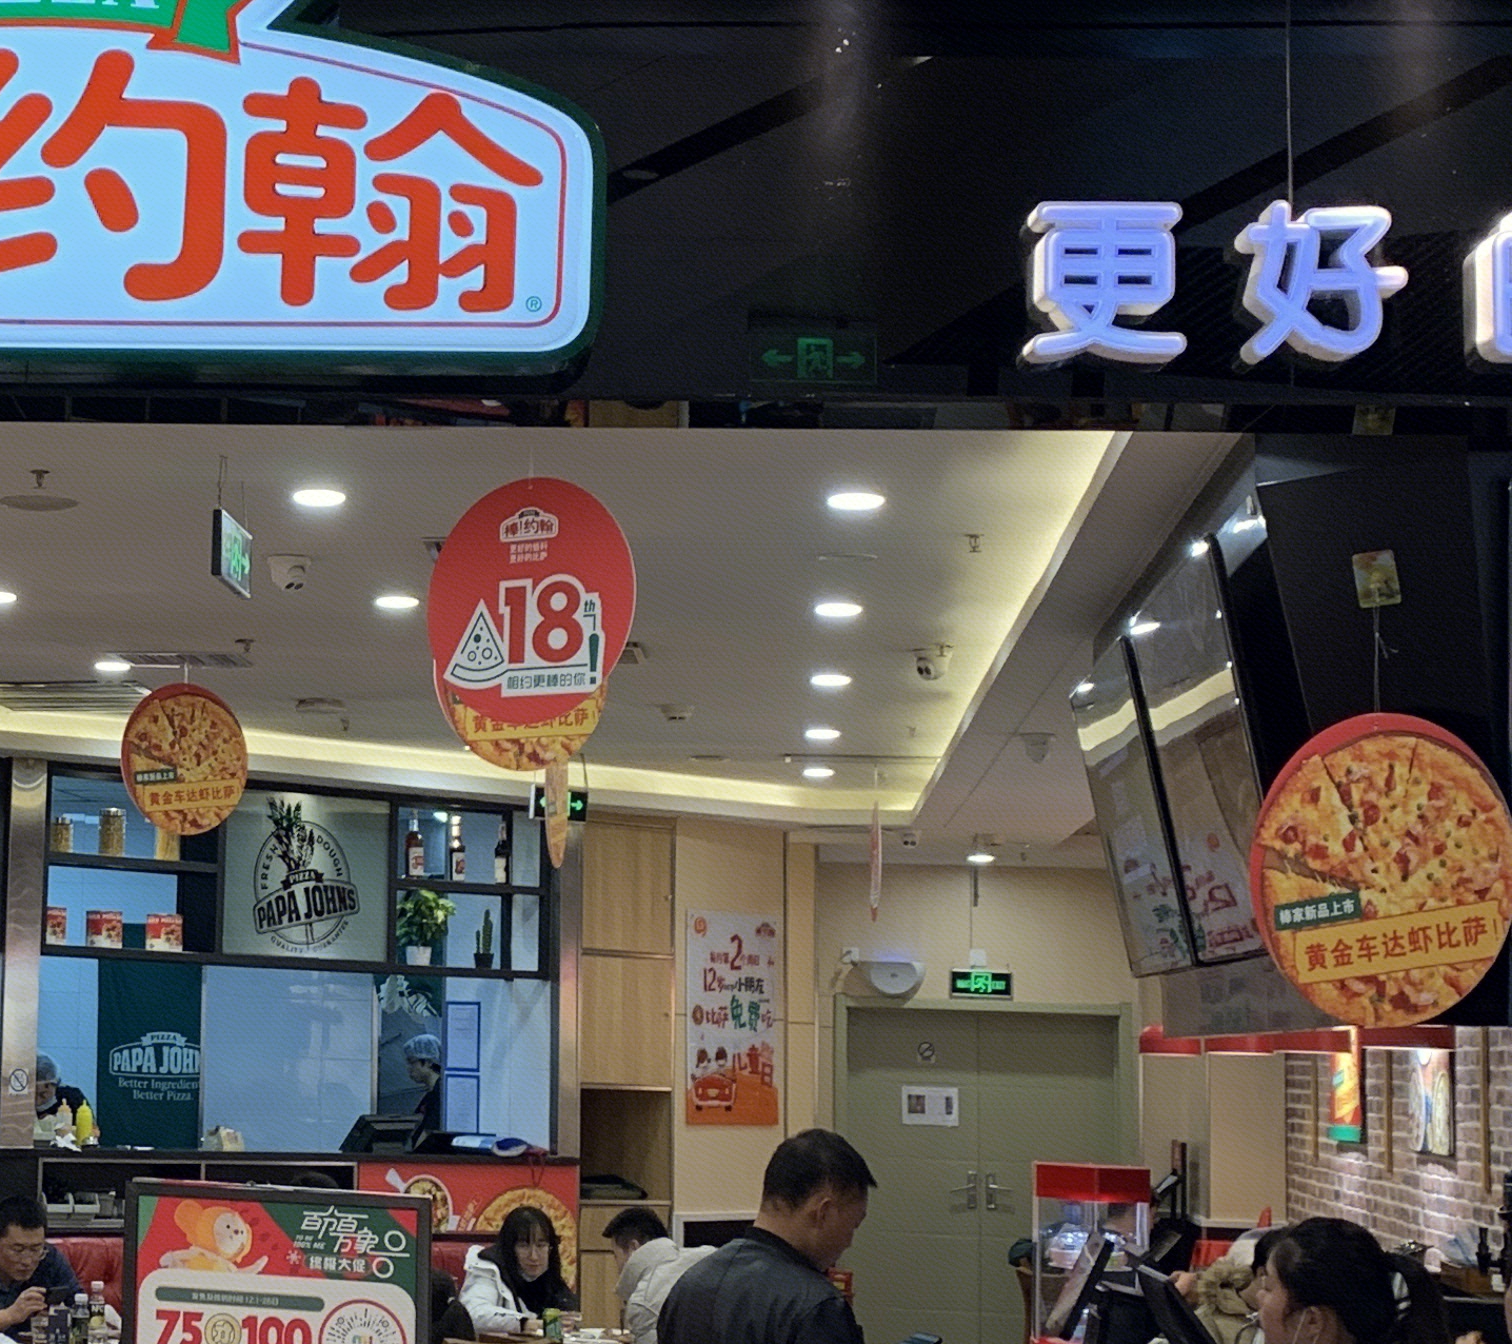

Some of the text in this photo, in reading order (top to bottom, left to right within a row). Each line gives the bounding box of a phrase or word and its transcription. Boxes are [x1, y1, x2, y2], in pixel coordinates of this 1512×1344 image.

[260, 834, 344, 891] FRESH DOUGH
[257, 884, 357, 930] PAPA JOHNS
[113, 1046, 157, 1074] PAPA
[118, 1077, 148, 1088] Better
[133, 1090, 164, 1100] Better
